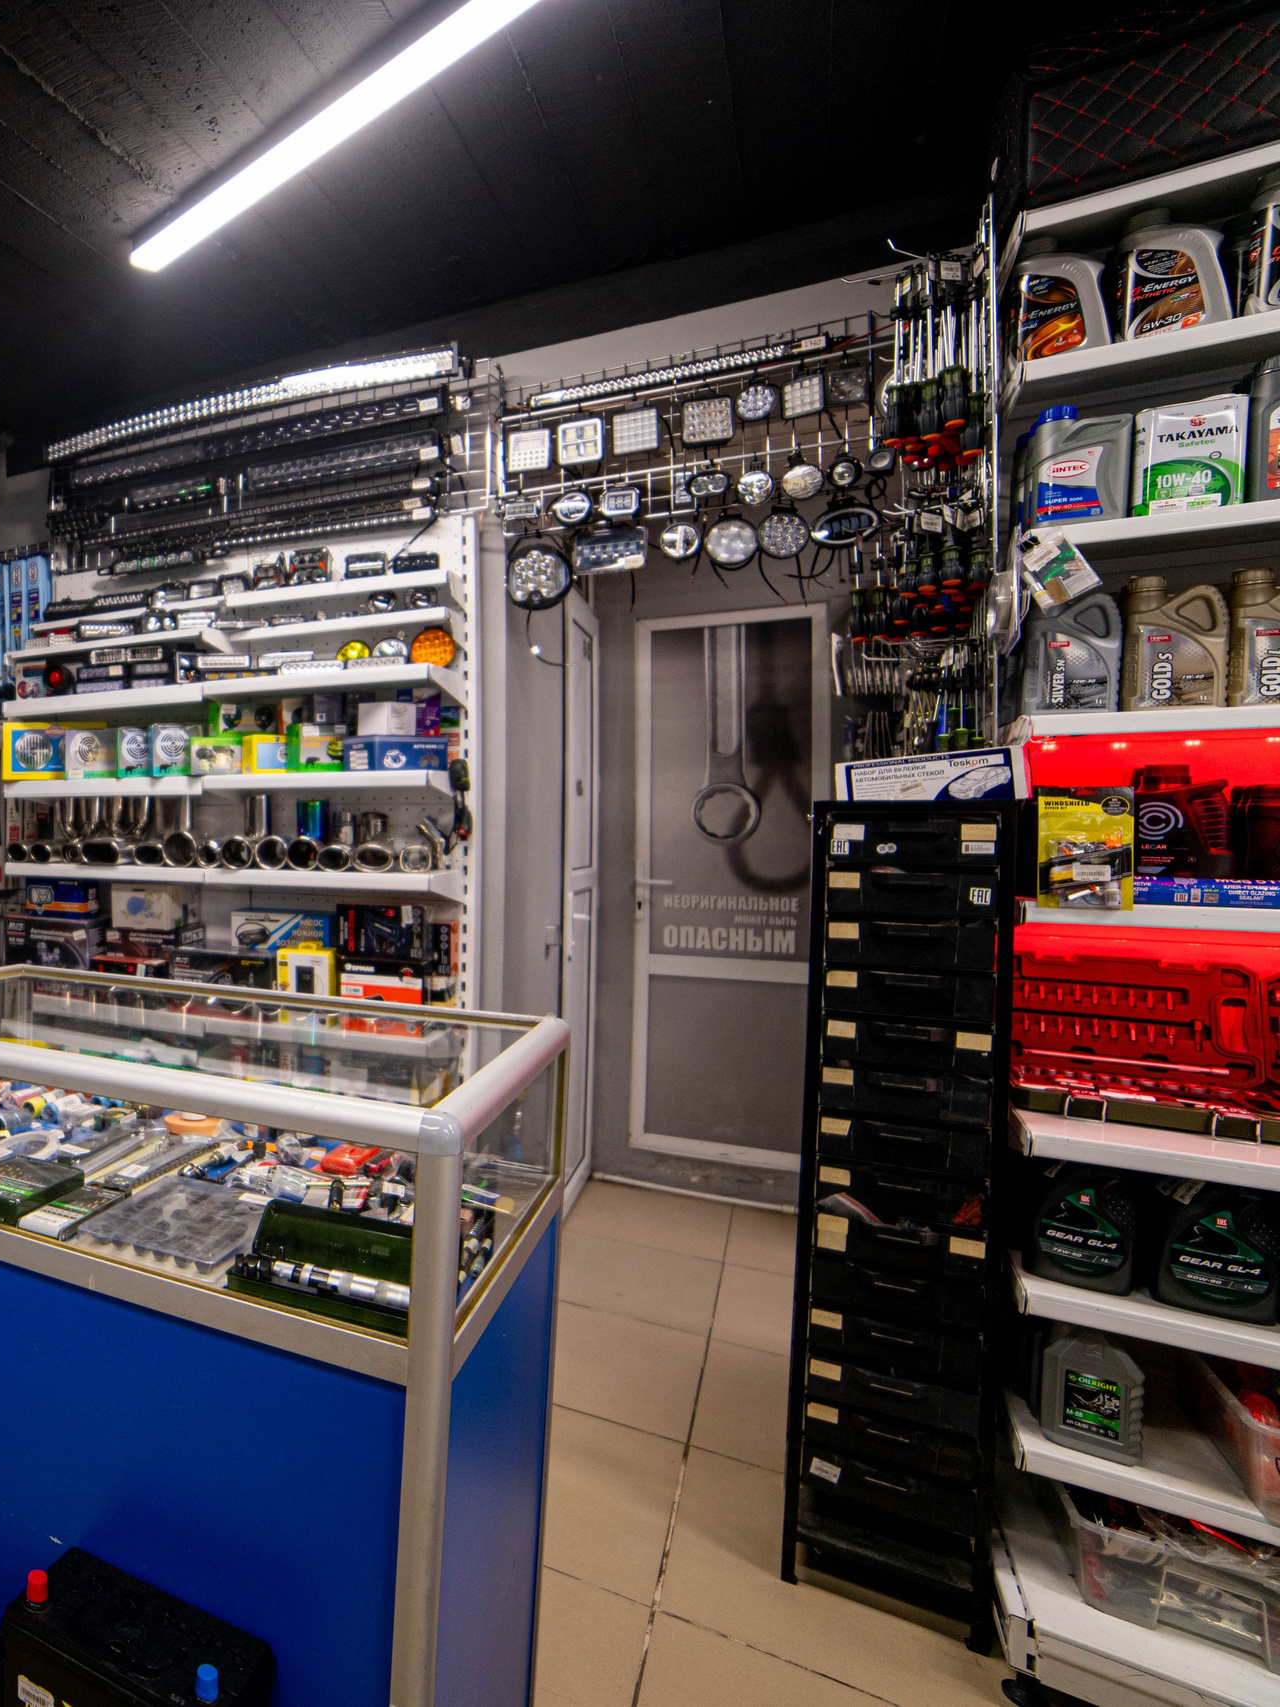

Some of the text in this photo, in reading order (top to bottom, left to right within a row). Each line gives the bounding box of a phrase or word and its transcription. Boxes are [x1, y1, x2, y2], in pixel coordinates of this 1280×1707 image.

[1141, 312, 1183, 332] 5W-30
[1157, 424, 1239, 443] TAKAYAMA
[1178, 438, 1216, 449] Safetec
[1048, 464, 1087, 475] SINTEC
[1156, 469, 1213, 489] 10W-40
[1044, 497, 1068, 505] SUPER
[1051, 659, 1066, 704] SILVER SN
[1151, 652, 1173, 700] GOLD S
[852, 754, 950, 769] PROFESSIONAL PRODUCTS
[947, 757, 989, 768] Teskom
[854, 764, 927, 777] НАБОР ДЛЯ ВКЛЕЙКИ
[855, 769, 945, 784] АВТОМОБИЛЬНЫХ СТЕКОЛ
[831, 840, 848, 854] EAC
[663, 894, 799, 912] НЕОРИГИНАЛЬНОЕ
[971, 888, 990, 904] EAC
[299, 919, 324, 927] НАСОС
[734, 914, 797, 926] МОЖЕТ БЫТЬ
[291, 930, 324, 938] НОЖНОЙ
[663, 925, 796, 955] ОПАСНЫМ
[1046, 1229, 1118, 1250] GEAR GL-4
[1179, 1255, 1262, 1276] GEAR GL-4
[1186, 1273, 1222, 1285] 80W-90
